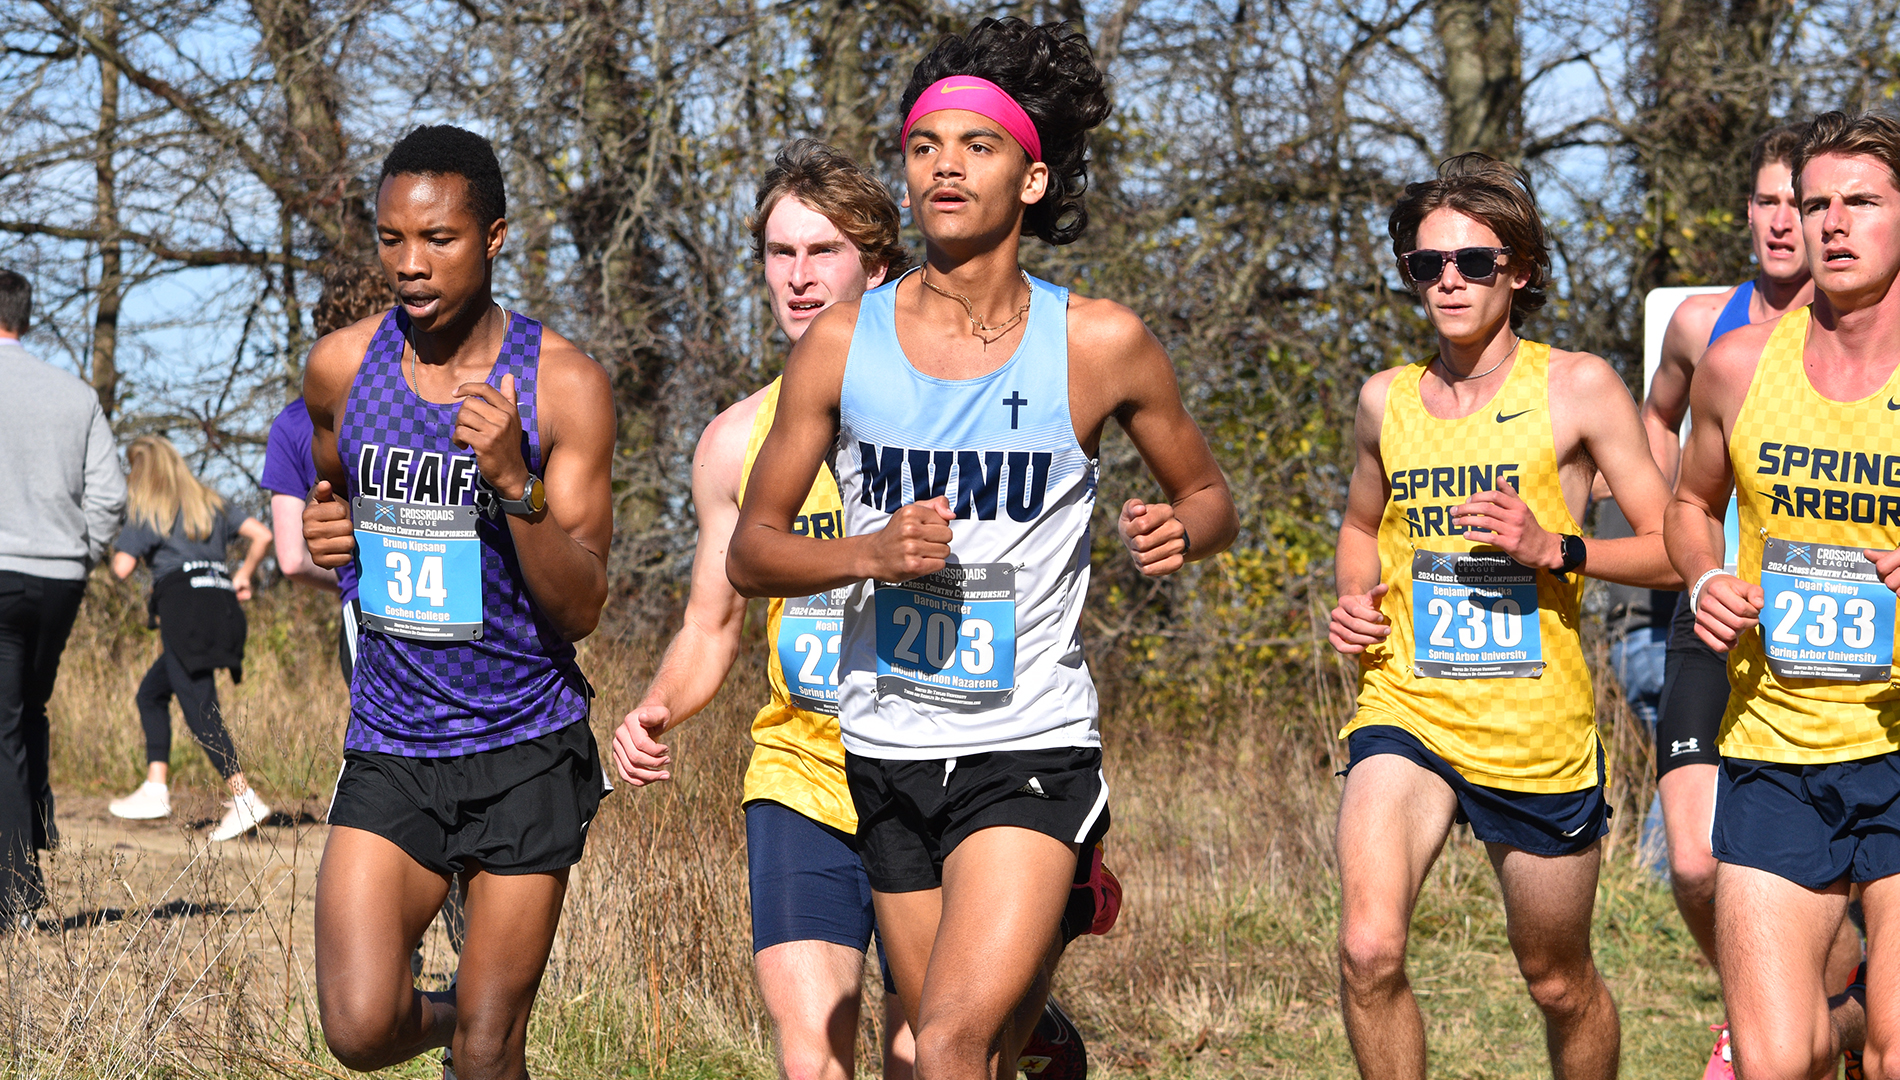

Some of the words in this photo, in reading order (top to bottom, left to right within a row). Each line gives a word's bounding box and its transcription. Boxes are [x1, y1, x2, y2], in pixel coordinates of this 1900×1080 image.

[1757, 441, 1900, 488] SPRING
[358, 444, 479, 506] LEAF
[858, 440, 1053, 523] MVNU
[1391, 463, 1520, 502] SPRING
[400, 507, 455, 521] CROSSROADS
[1758, 484, 1900, 527] ARBOR
[360, 521, 378, 531] 2024
[400, 519, 437, 527] LEAGUE
[791, 509, 843, 539] PRI
[383, 537, 408, 550] Bruno
[409, 540, 447, 554] Kipsang
[1457, 555, 1512, 567] CROSSROADS
[1768, 561, 1787, 572] 2024
[1816, 559, 1855, 569] LEAGUE
[385, 551, 449, 608] 34
[930, 575, 967, 587] LEAGUE
[931, 567, 987, 580] ROSSROADS
[1418, 571, 1435, 581] 2024
[1433, 585, 1474, 598] Benjamin
[1794, 578, 1823, 591] Logan
[1824, 581, 1859, 597] Swiney
[790, 606, 809, 616] 2024
[914, 593, 941, 610] Daron
[942, 598, 972, 616] Porter
[385, 605, 414, 620] Goshen
[415, 607, 450, 623] College
[1771, 590, 1876, 649] 233
[815, 620, 838, 632] Noah
[1427, 598, 1523, 649] 230
[892, 605, 995, 676] 203
[1428, 648, 1455, 663] Spring
[1455, 650, 1480, 662] Arbor
[1481, 650, 1527, 662] University
[1770, 645, 1798, 660] Spring
[1799, 647, 1827, 661] Arbor
[1828, 649, 1877, 664] University
[891, 662, 917, 678] Mount
[917, 669, 951, 685] Vernon
[952, 674, 999, 690] Nazarene
[798, 685, 825, 700] Spring
